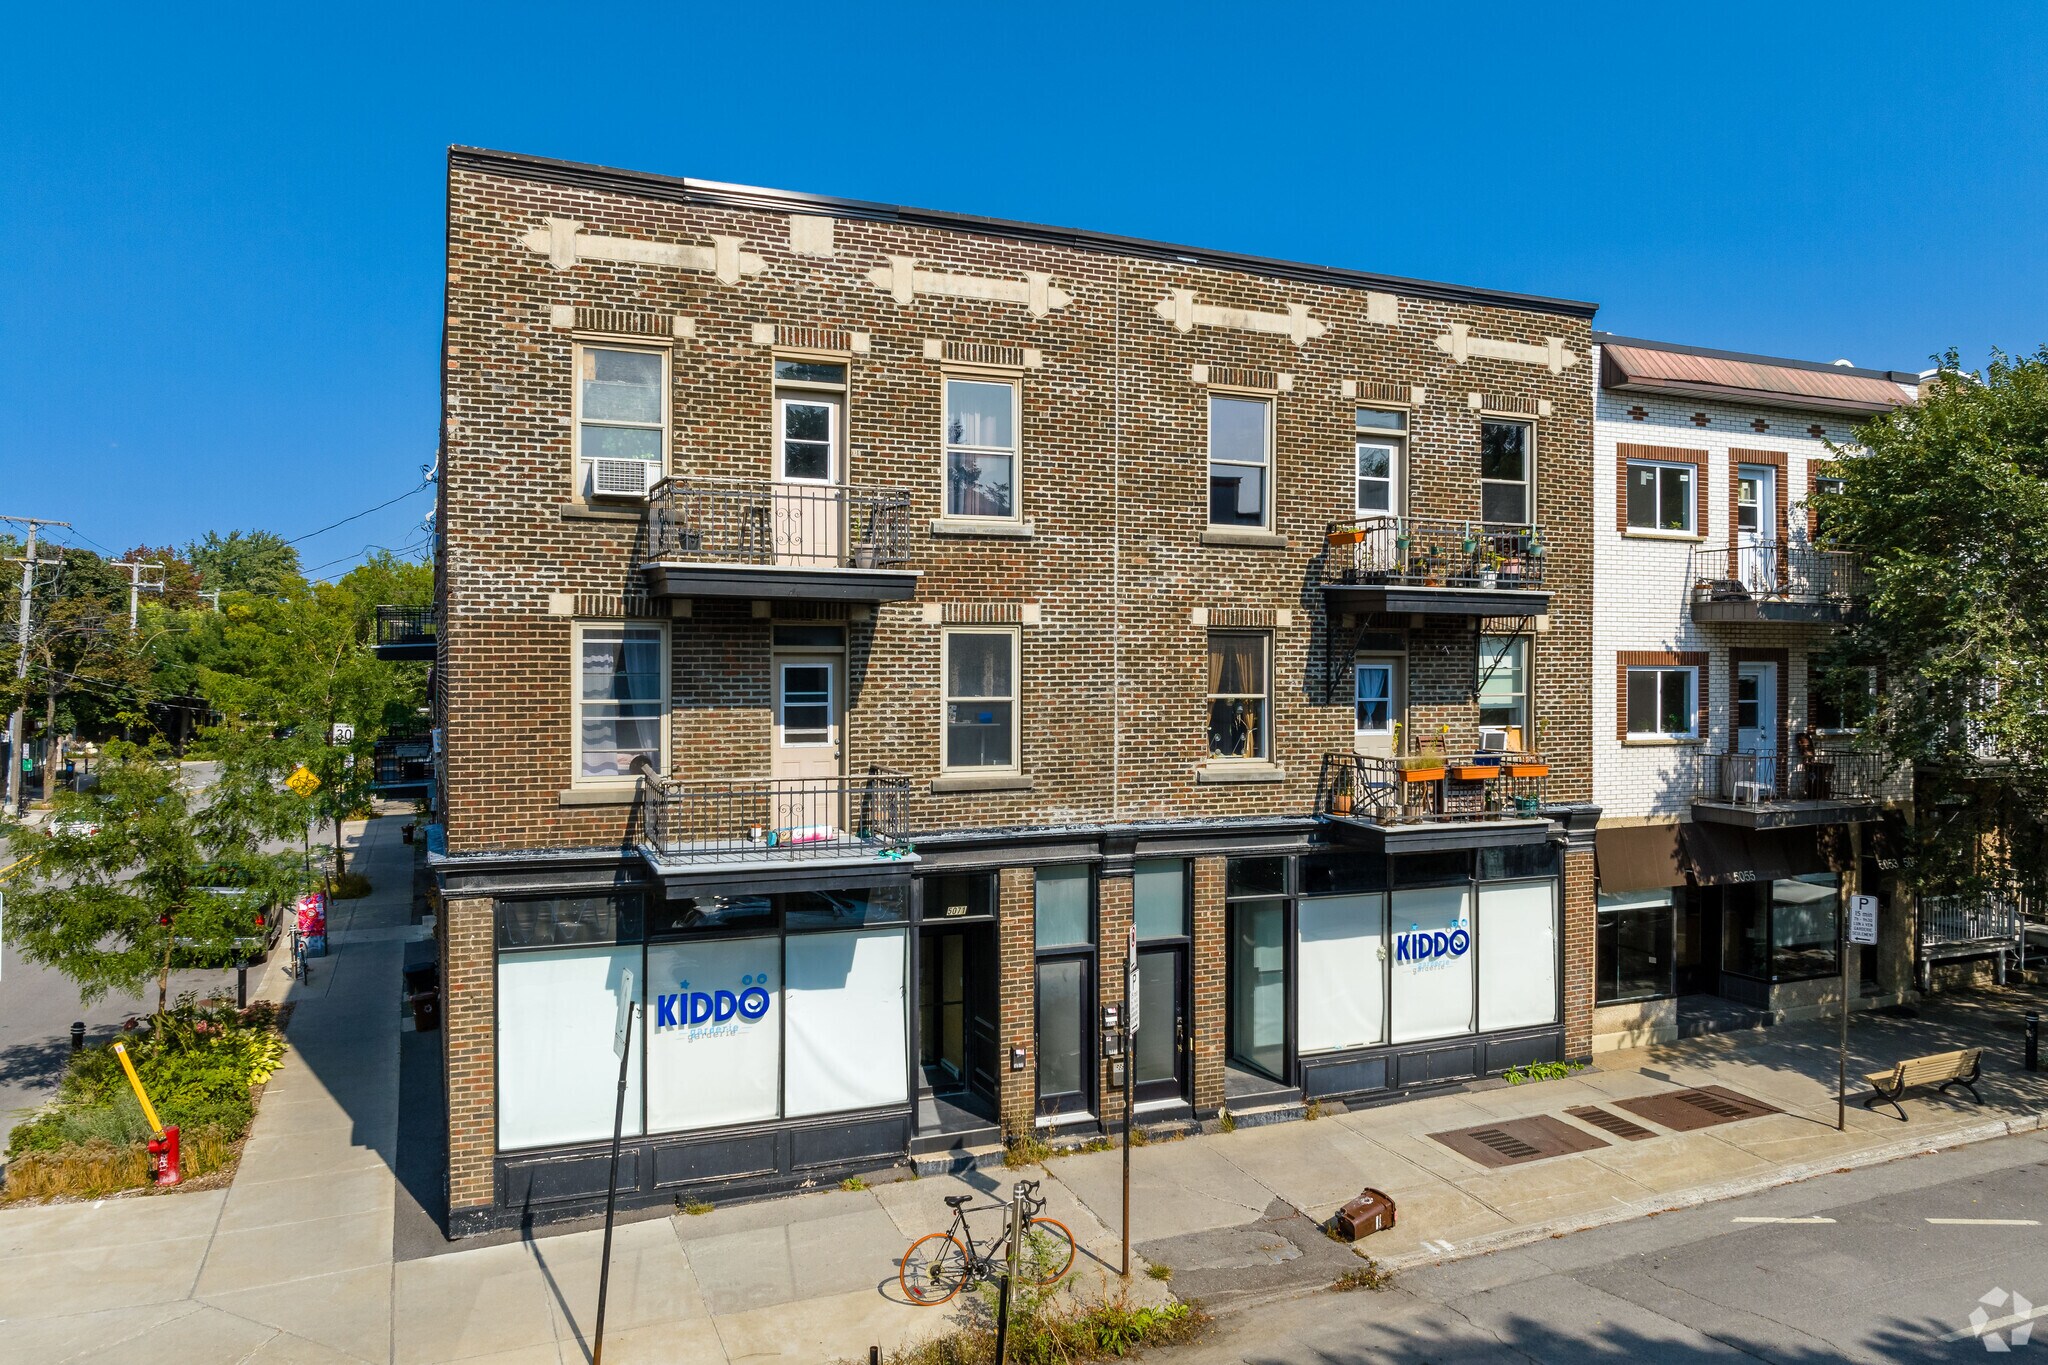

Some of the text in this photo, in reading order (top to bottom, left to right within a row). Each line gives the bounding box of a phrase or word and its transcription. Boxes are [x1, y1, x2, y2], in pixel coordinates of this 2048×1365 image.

[337, 728, 352, 741] 30
[1877, 858, 1899, 870] 5053
[1733, 870, 1756, 882] 5055
[1859, 897, 1869, 910] P
[947, 906, 966, 915] 5071
[690, 1024, 739, 1042] garderie
